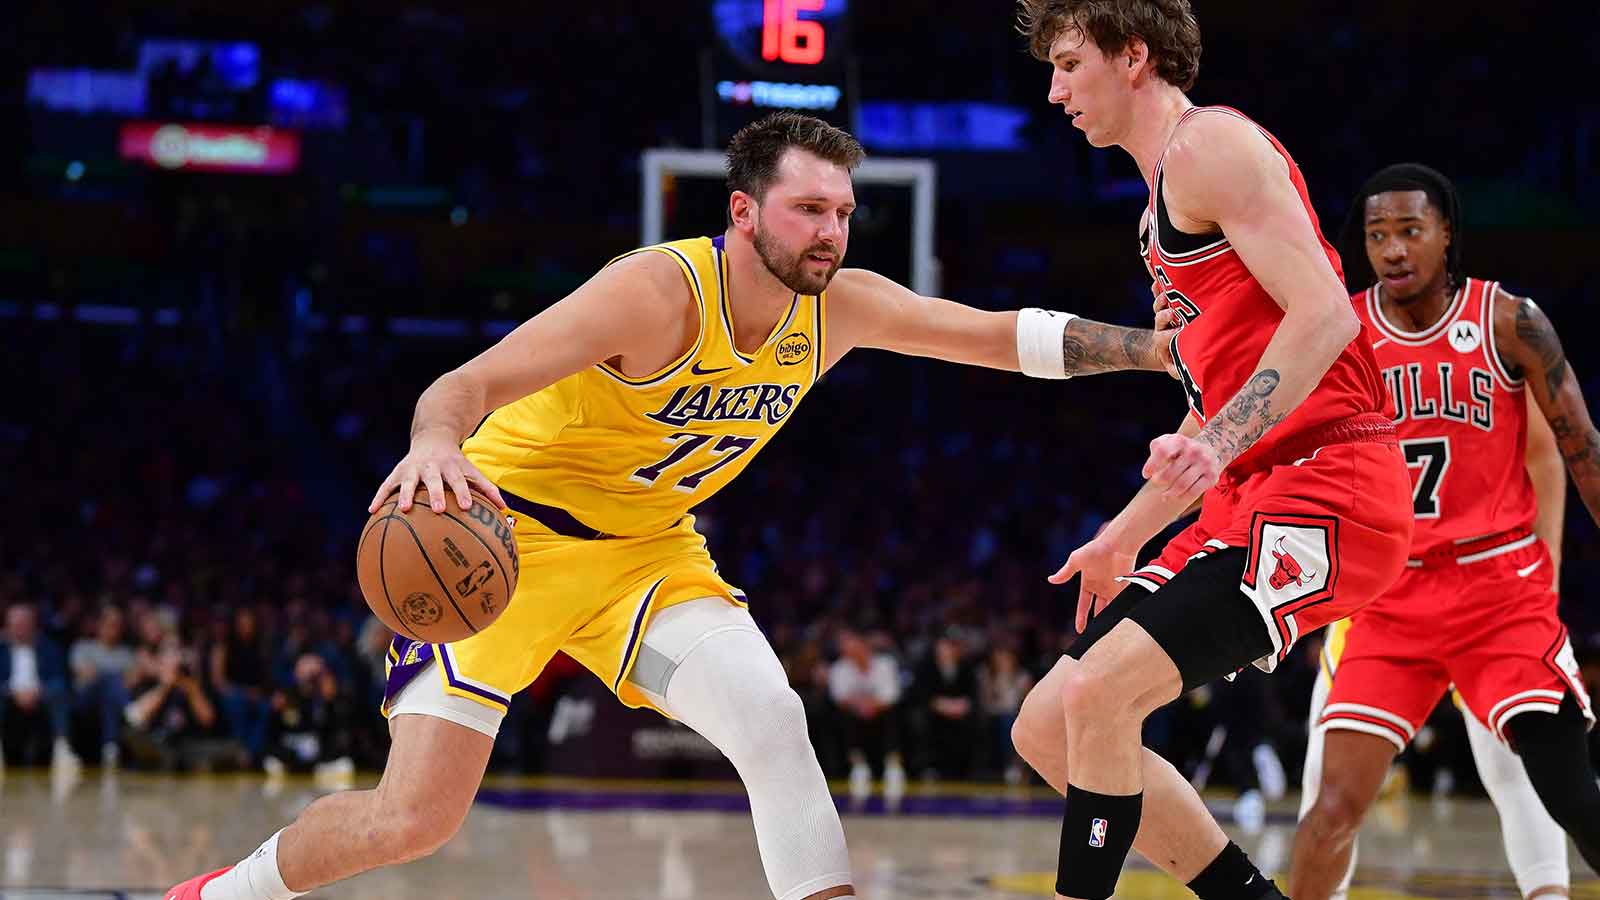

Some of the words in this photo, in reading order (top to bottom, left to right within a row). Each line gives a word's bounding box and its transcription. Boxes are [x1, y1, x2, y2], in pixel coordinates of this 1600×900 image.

[762, 0, 825, 64] 16
[643, 383, 802, 428] LAKERS
[1381, 362, 1494, 431] ULLS
[628, 432, 760, 493] 77
[1399, 436, 1450, 519] 7
